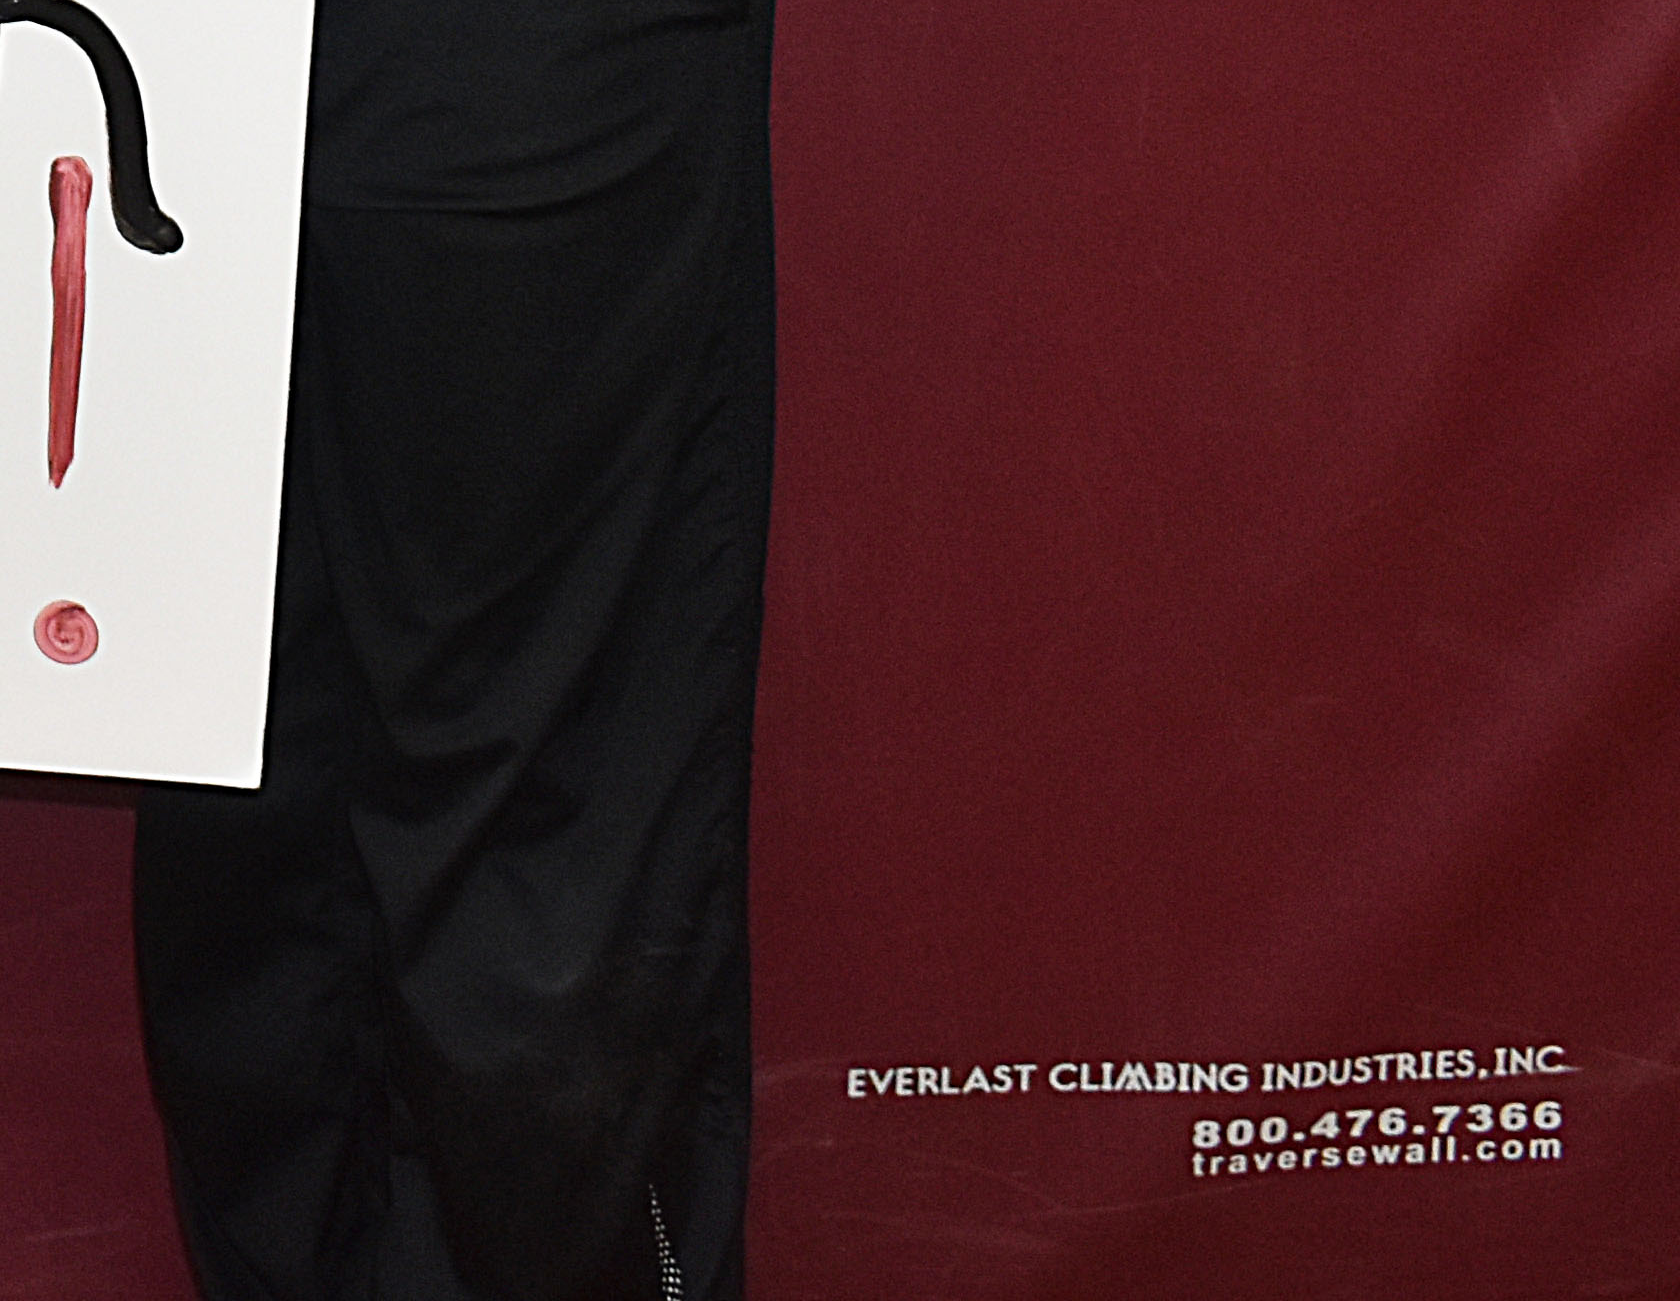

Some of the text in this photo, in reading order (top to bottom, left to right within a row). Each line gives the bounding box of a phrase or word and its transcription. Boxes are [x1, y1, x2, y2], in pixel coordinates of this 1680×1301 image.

[847, 1064, 1038, 1098] EVERLAST
[1048, 1060, 1250, 1094] CLIMBING
[1192, 1100, 1564, 1149] 800.476.7366
[1192, 1134, 1564, 1177] traversewall.com
